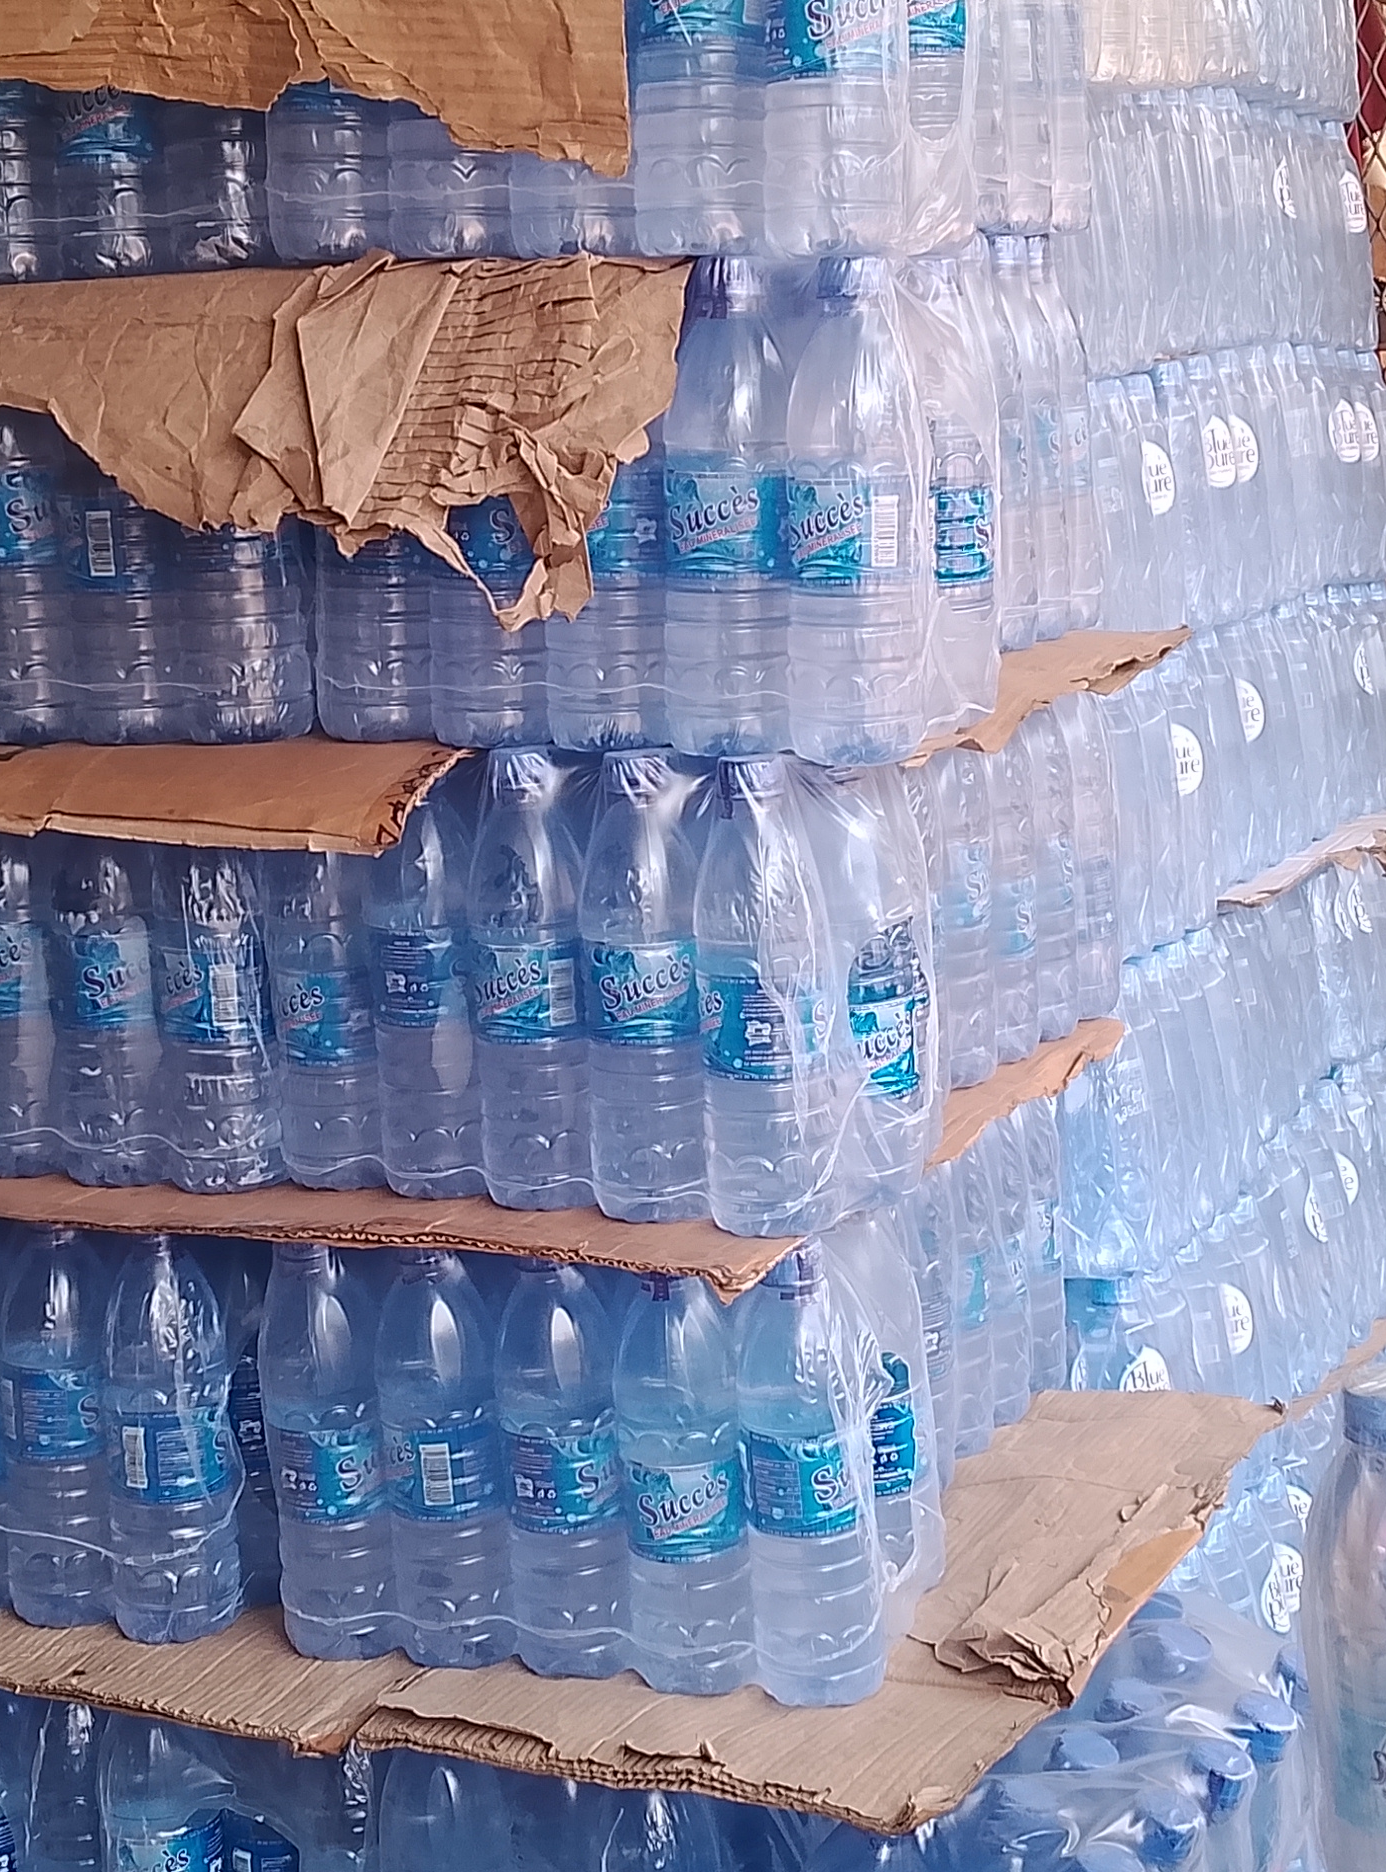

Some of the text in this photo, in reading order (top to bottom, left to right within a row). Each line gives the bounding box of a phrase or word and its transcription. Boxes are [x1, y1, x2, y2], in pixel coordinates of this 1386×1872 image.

[669, 486, 760, 541] Succès
[600, 955, 693, 1010] Succès
[857, 1014, 913, 1059] uccès
[638, 1471, 729, 1526] Succès
